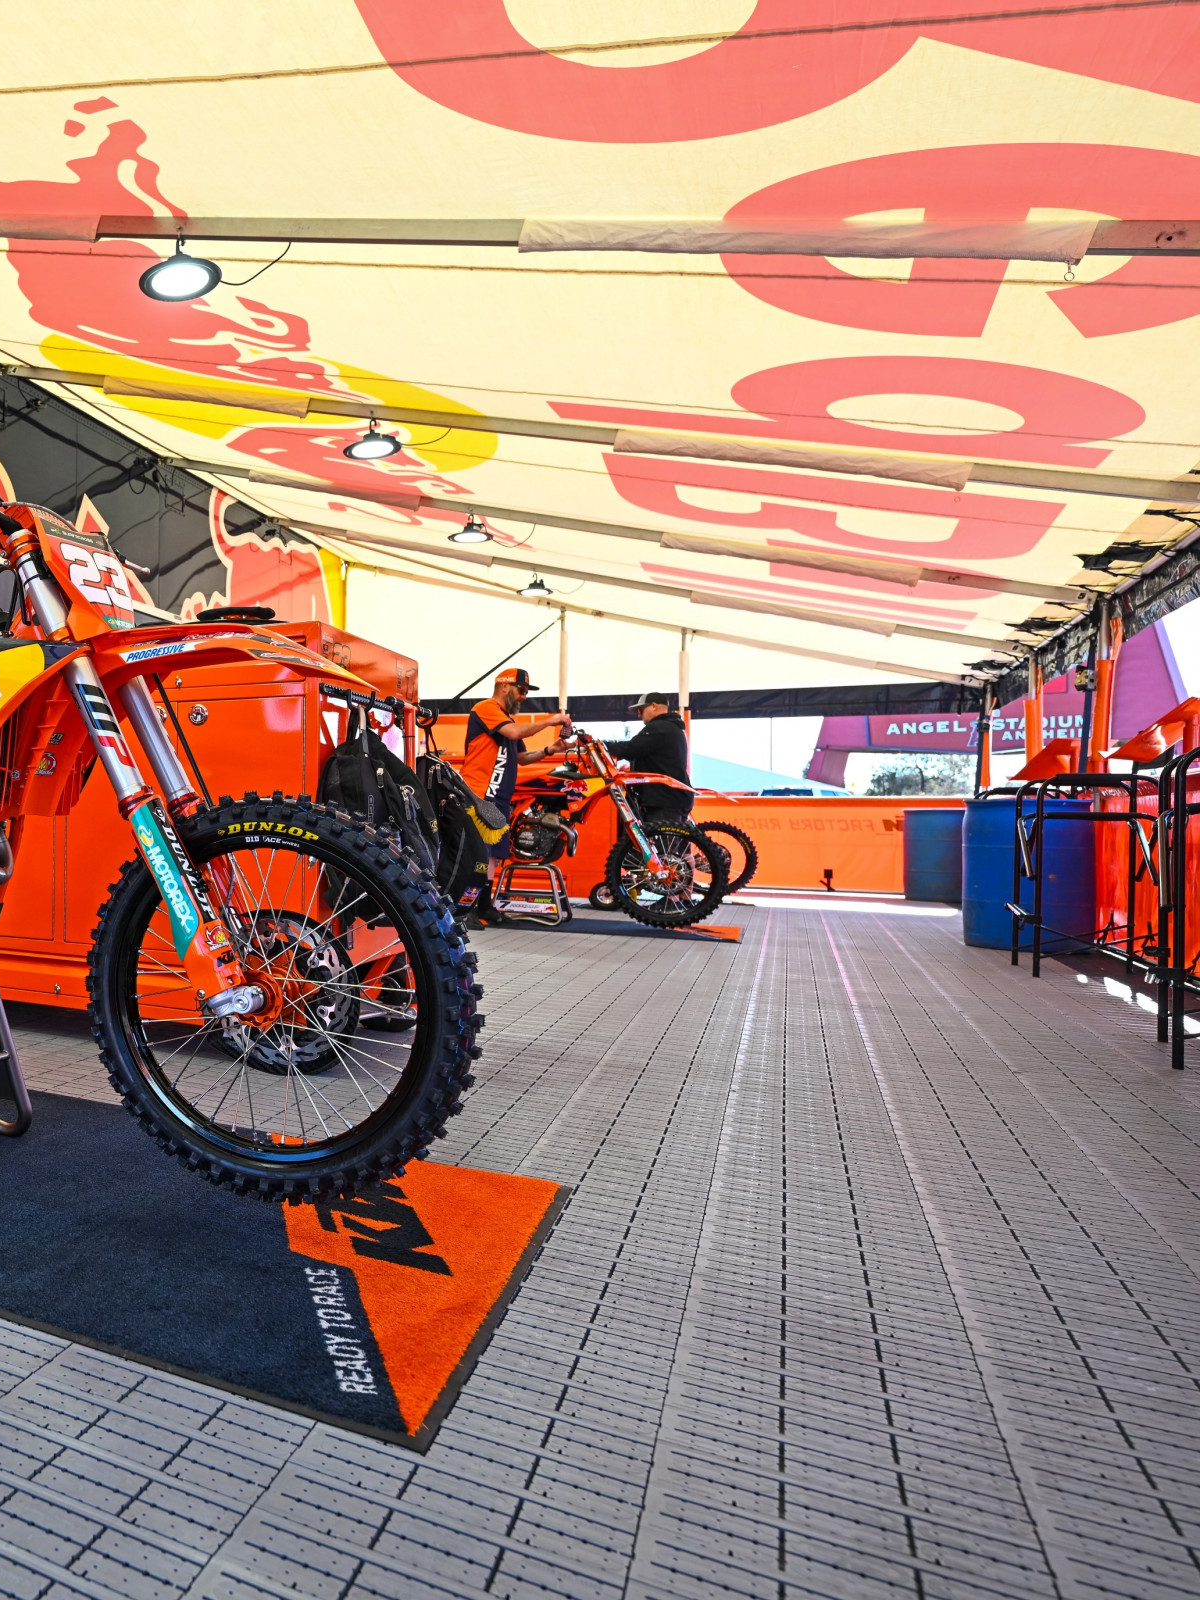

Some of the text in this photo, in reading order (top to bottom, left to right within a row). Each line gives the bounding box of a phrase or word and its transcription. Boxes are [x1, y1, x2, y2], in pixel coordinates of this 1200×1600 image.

[59, 541, 134, 613] 23
[126, 643, 186, 662] PROGRESSIVE
[886, 720, 967, 735] ANGEL
[1002, 728, 1091, 741] ANHEI
[228, 821, 320, 841] DUNLOP
[146, 845, 195, 929] MOTOREX
[162, 826, 216, 920] DUNLOP
[303, 1267, 379, 1396] READY TO RACE
